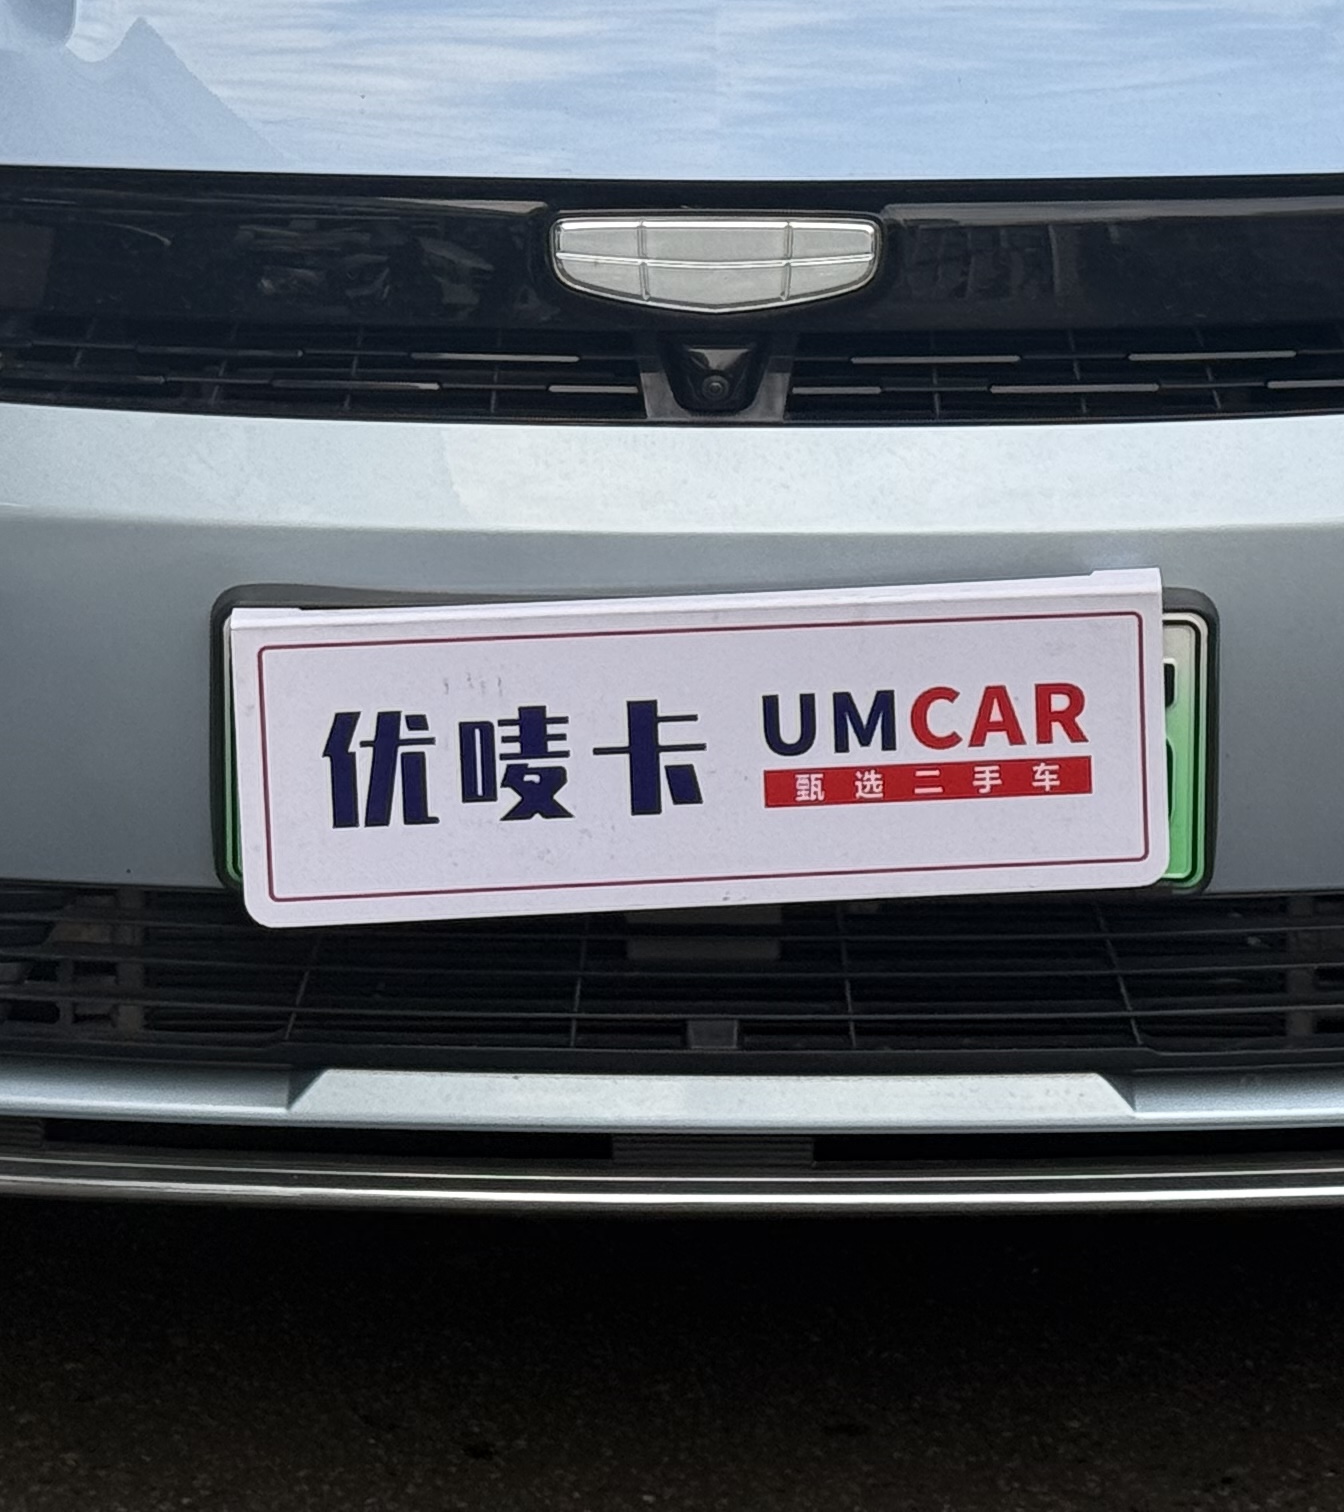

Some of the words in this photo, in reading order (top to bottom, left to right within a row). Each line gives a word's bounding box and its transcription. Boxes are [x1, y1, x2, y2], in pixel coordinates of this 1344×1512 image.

[761, 682, 1090, 757] UMCAR
[322, 699, 708, 829] 优唛卡
[794, 761, 1061, 802] 甄选二手车
